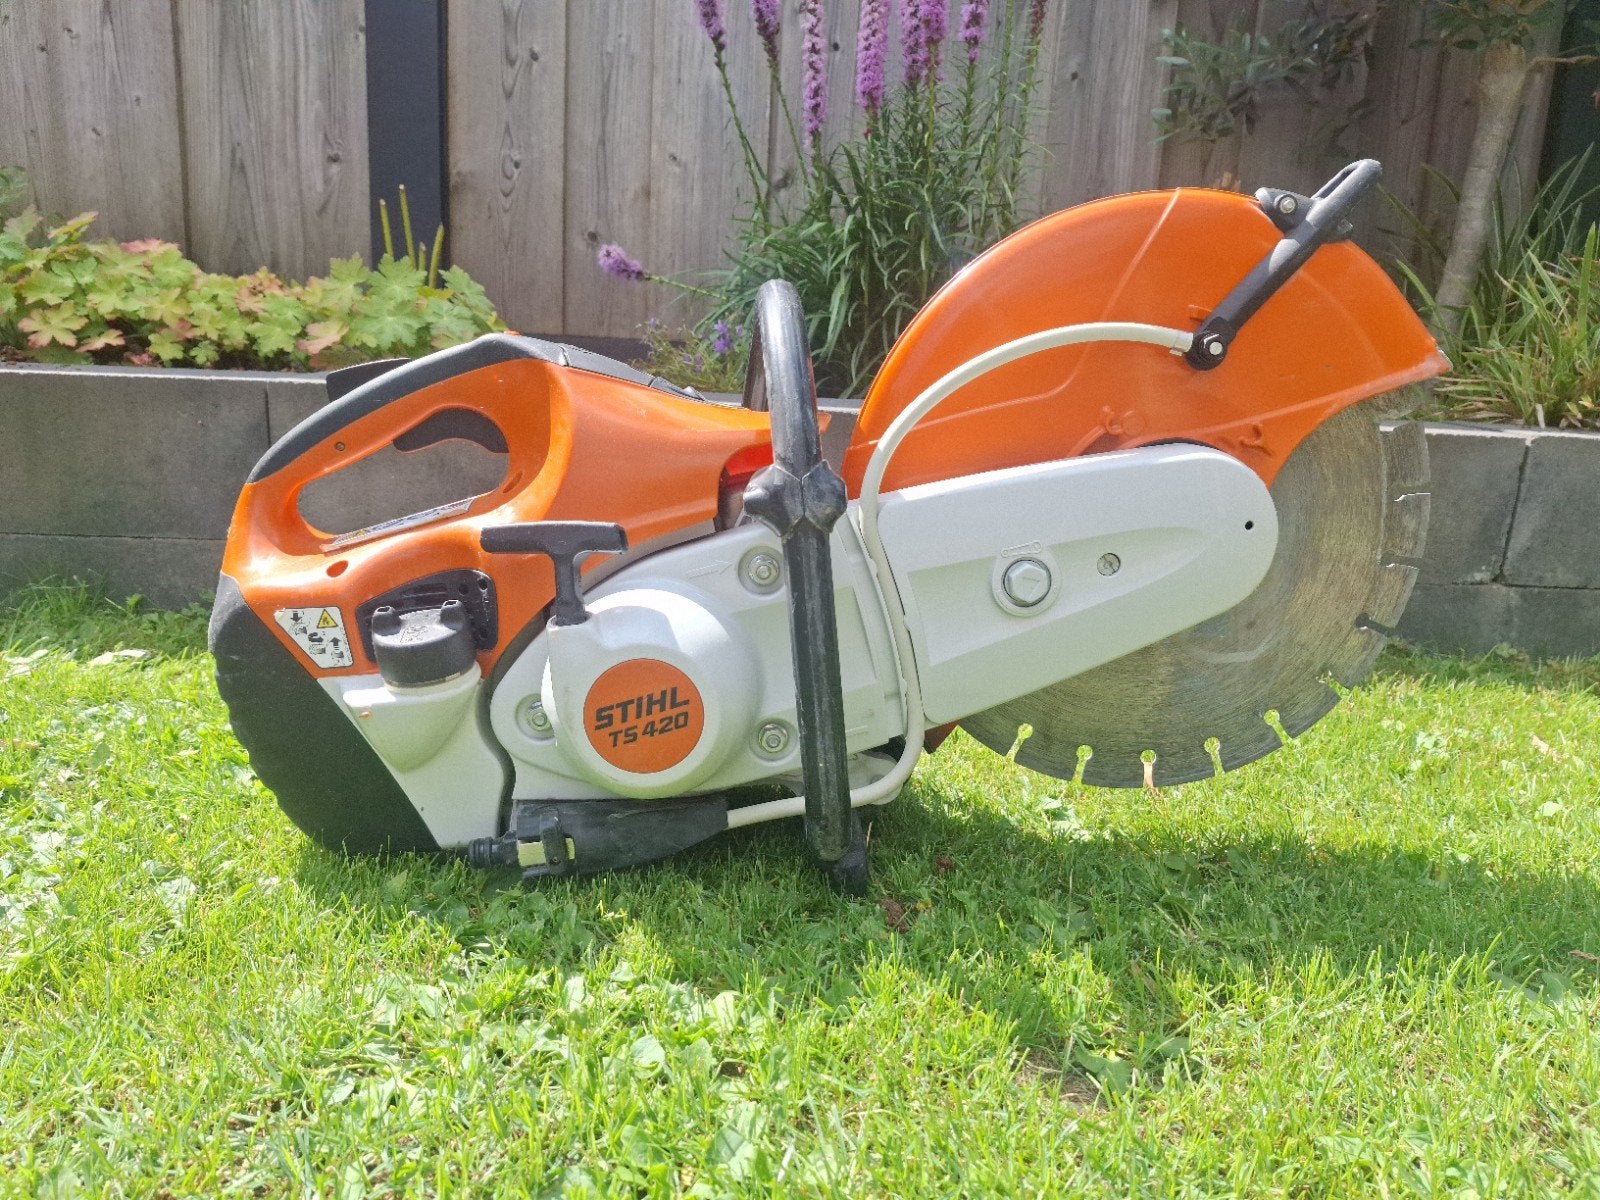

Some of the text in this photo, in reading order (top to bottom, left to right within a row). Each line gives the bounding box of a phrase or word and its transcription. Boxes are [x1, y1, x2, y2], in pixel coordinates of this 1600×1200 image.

[594, 687, 690, 731] STIHL
[608, 711, 689, 748] TS 420
